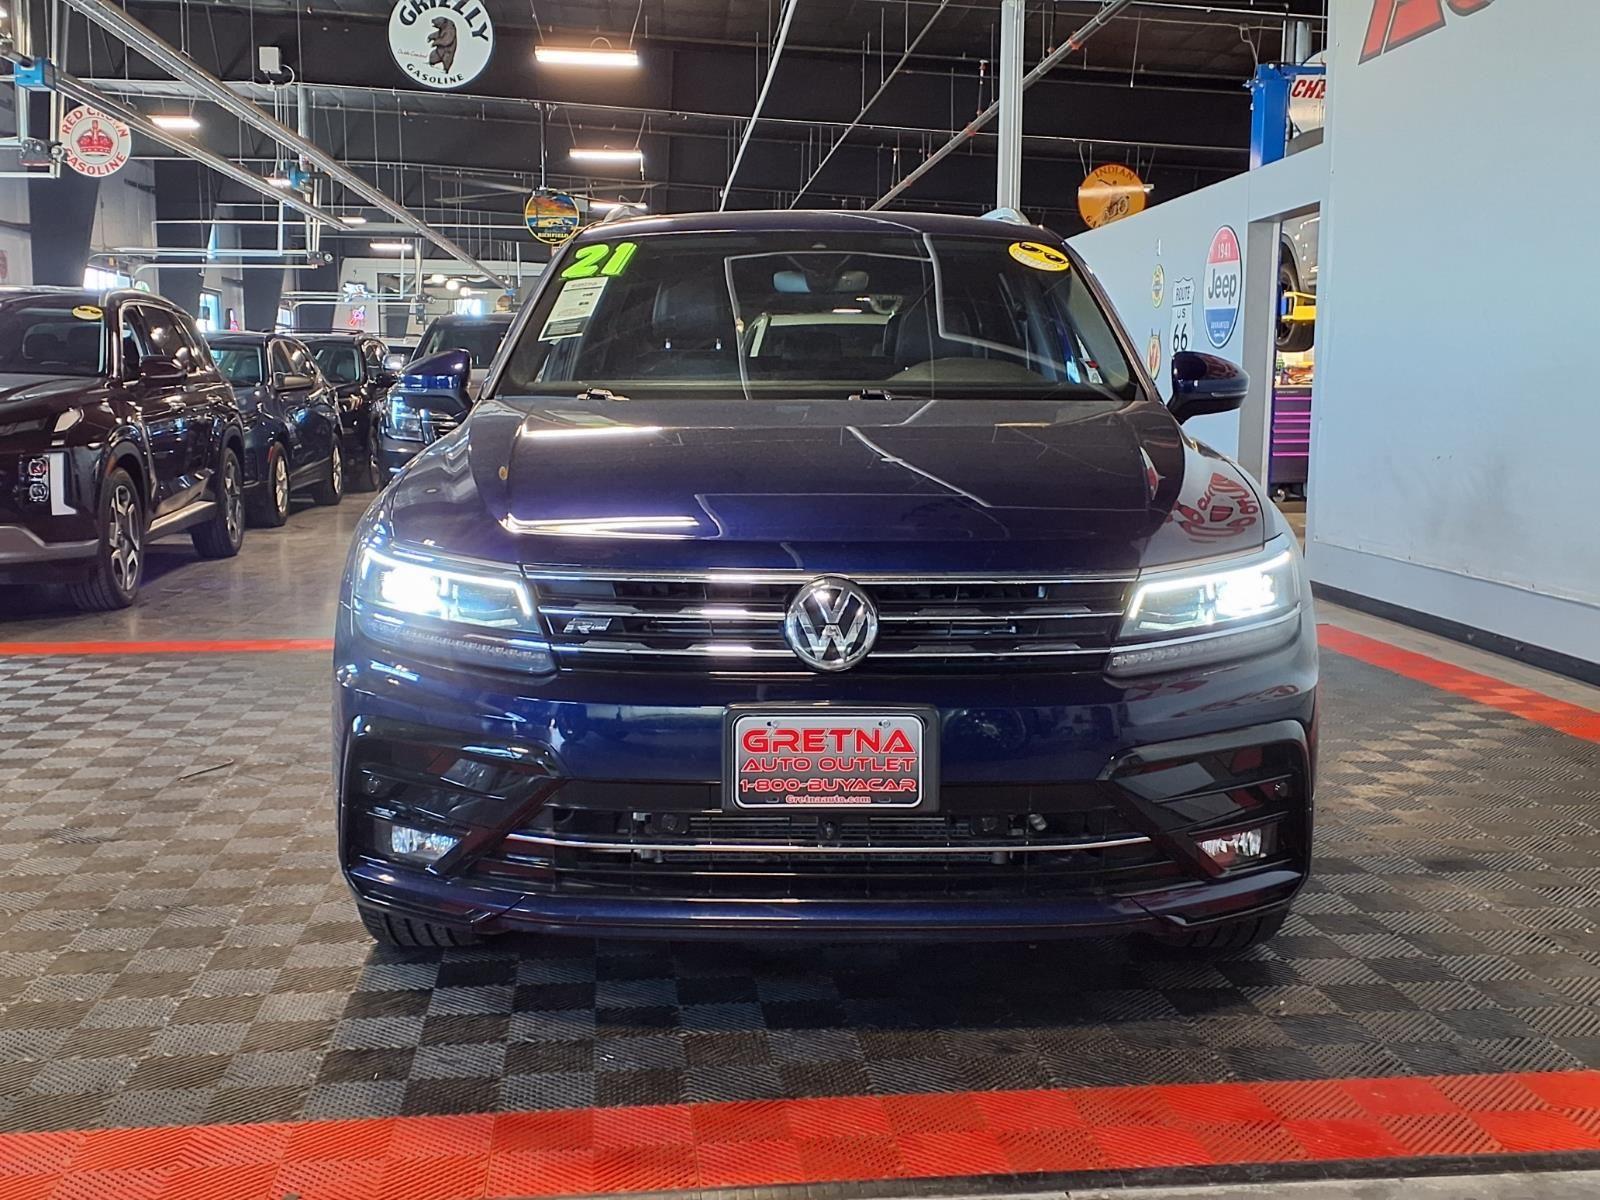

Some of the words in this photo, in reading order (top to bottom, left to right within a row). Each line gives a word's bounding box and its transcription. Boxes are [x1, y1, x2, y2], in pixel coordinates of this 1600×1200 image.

[406, 63, 464, 84] GASOLINE
[62, 110, 83, 134] RED
[64, 148, 127, 175] GASOLINE
[1094, 166, 1135, 181] INDIAN
[1217, 241, 1231, 259] 1941
[561, 242, 637, 278] 21
[1175, 286, 1191, 301] ROUTE
[1207, 268, 1237, 304] Jeep
[1176, 308, 1186, 319] US
[1172, 322, 1188, 352] 66
[742, 728, 917, 754] GRETNA
[741, 757, 812, 773] AUTO
[818, 757, 917, 773] OUTLET
[740, 778, 917, 793] 1-800-BUYACAR
[785, 794, 872, 804] Gretnaauto.com
